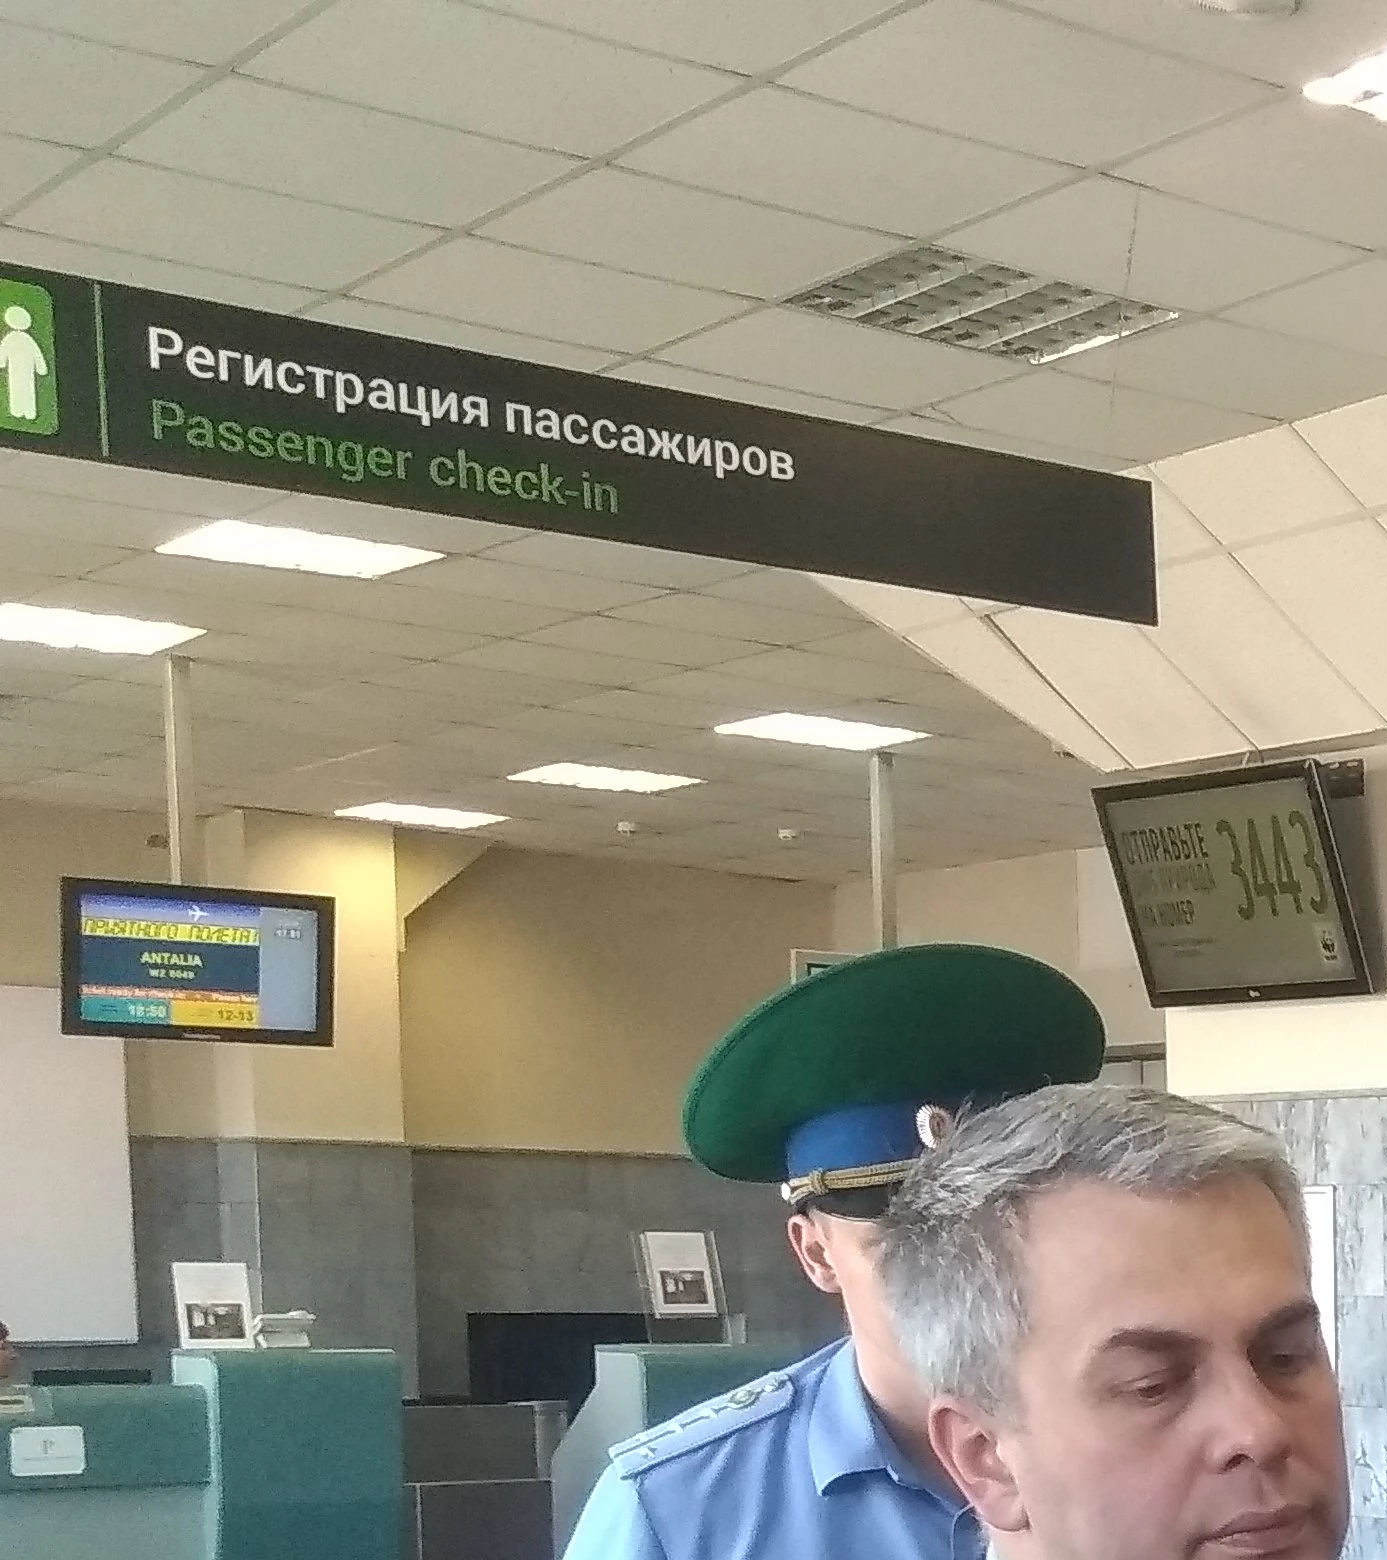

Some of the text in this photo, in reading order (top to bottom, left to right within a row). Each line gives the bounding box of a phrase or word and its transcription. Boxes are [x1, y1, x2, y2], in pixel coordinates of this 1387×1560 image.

[148, 326, 796, 480] Регистрация пассажиров
[151, 399, 620, 514] Passenger check-in
[1121, 822, 1209, 865] ОТПРАВЬТЕ
[1215, 810, 1328, 921] 3443
[139, 951, 204, 968] ANTALIA
